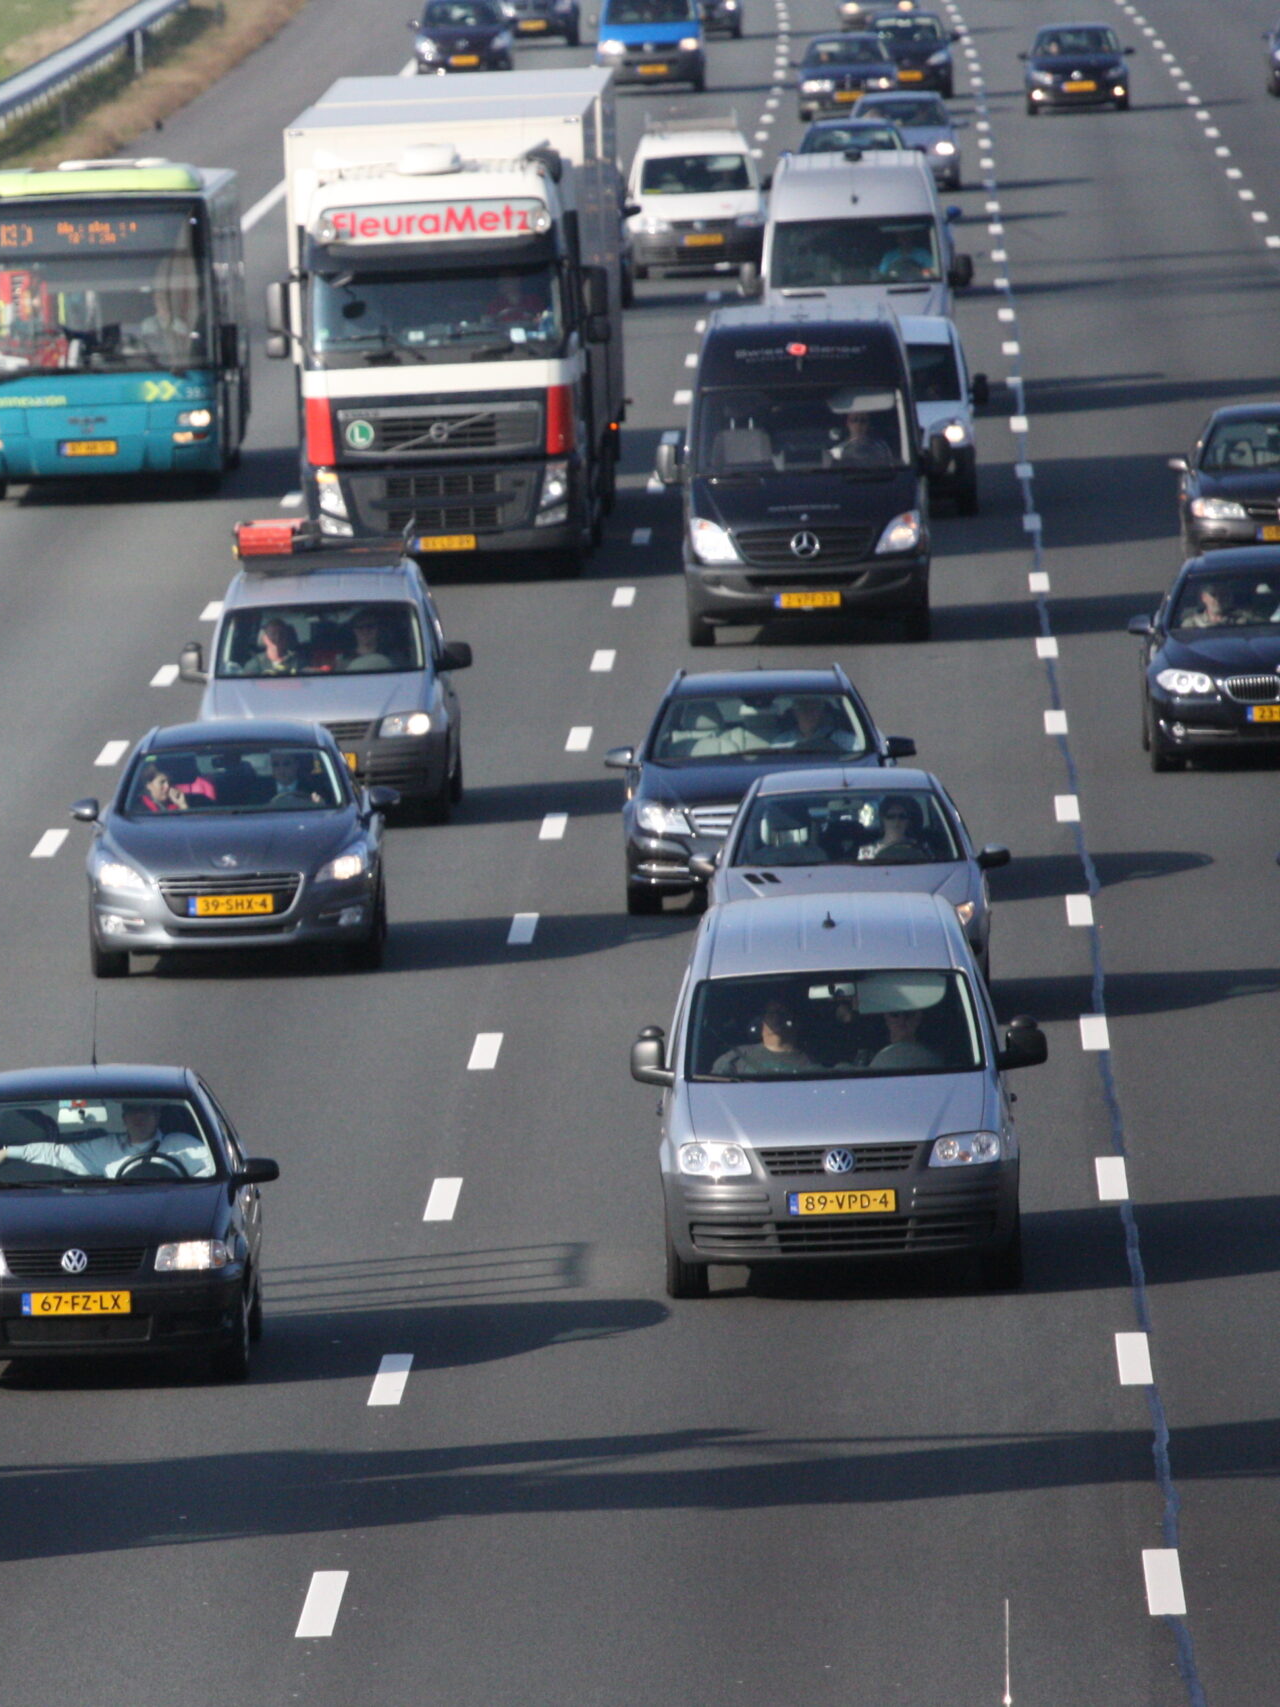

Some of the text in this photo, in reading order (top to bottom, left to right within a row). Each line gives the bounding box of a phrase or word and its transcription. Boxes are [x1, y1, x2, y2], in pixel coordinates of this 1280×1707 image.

[331, 204, 531, 238] FleuraMetz
[353, 424, 367, 443] L
[202, 897, 268, 912] 39-SHX-4
[805, 1192, 889, 1211] 89-VPD-4
[40, 1294, 121, 1312] 67-FZ-LX
